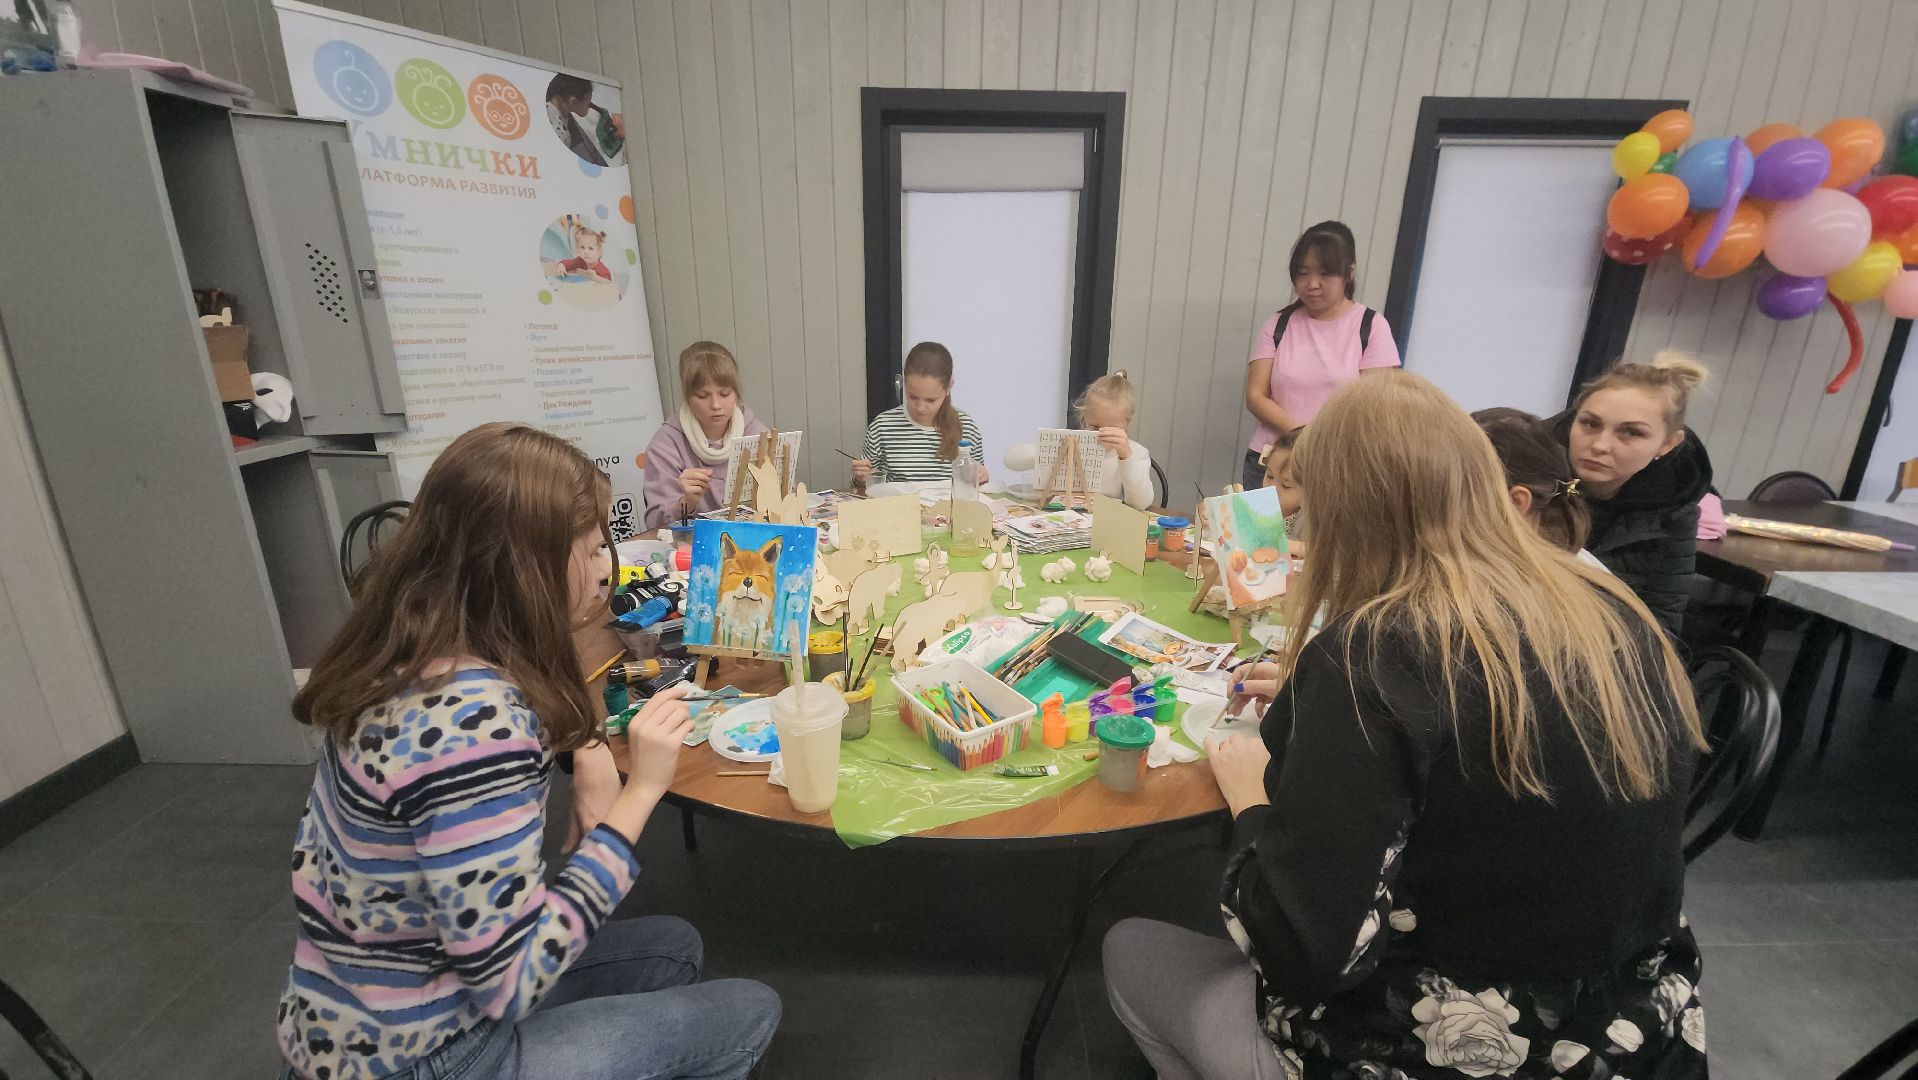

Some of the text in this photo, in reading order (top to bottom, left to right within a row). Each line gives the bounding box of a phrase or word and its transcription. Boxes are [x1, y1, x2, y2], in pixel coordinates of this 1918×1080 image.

[361, 167, 537, 199] ЛАТФОРМА РАЗВИТИЯ
[528, 322, 559, 331] Логопед
[434, 336, 467, 345] занятия
[530, 333, 548, 342] Йога
[439, 351, 467, 360] сказку
[535, 356, 556, 366] Уроки
[557, 354, 596, 363] английского
